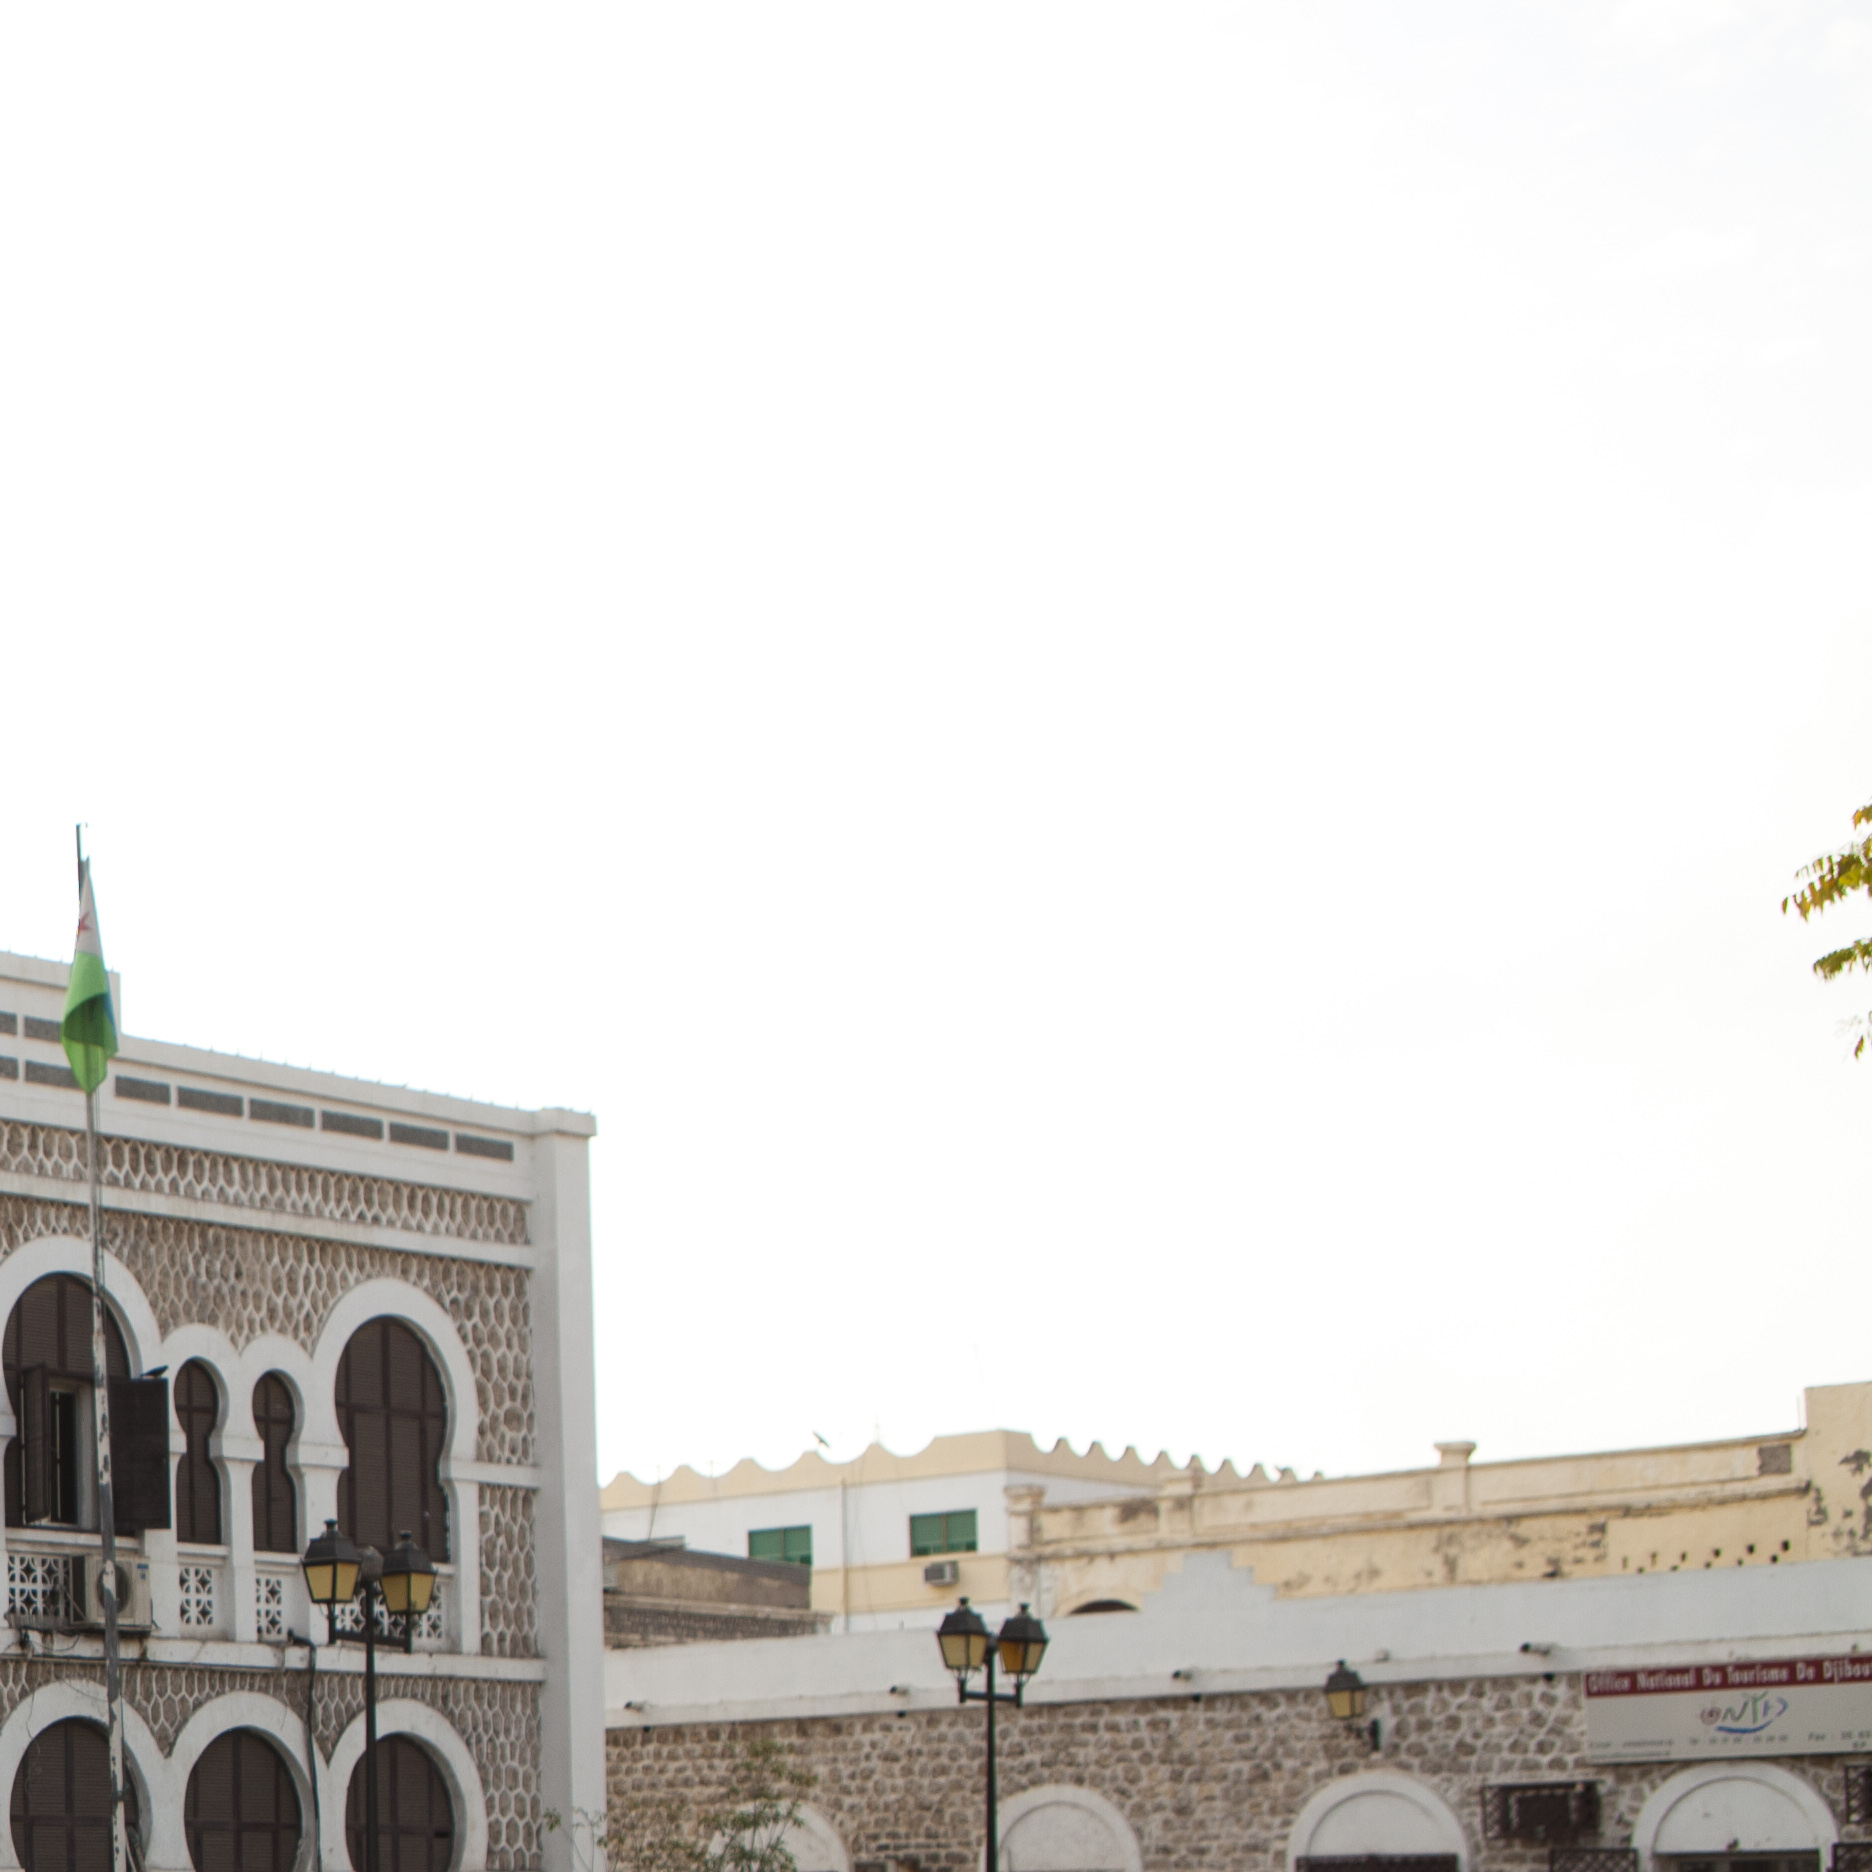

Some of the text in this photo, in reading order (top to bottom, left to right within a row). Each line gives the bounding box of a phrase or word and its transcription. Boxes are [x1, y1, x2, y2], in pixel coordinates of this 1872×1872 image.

[1587, 1658, 1872, 1693] Office National Du Tourisme De Djibou
